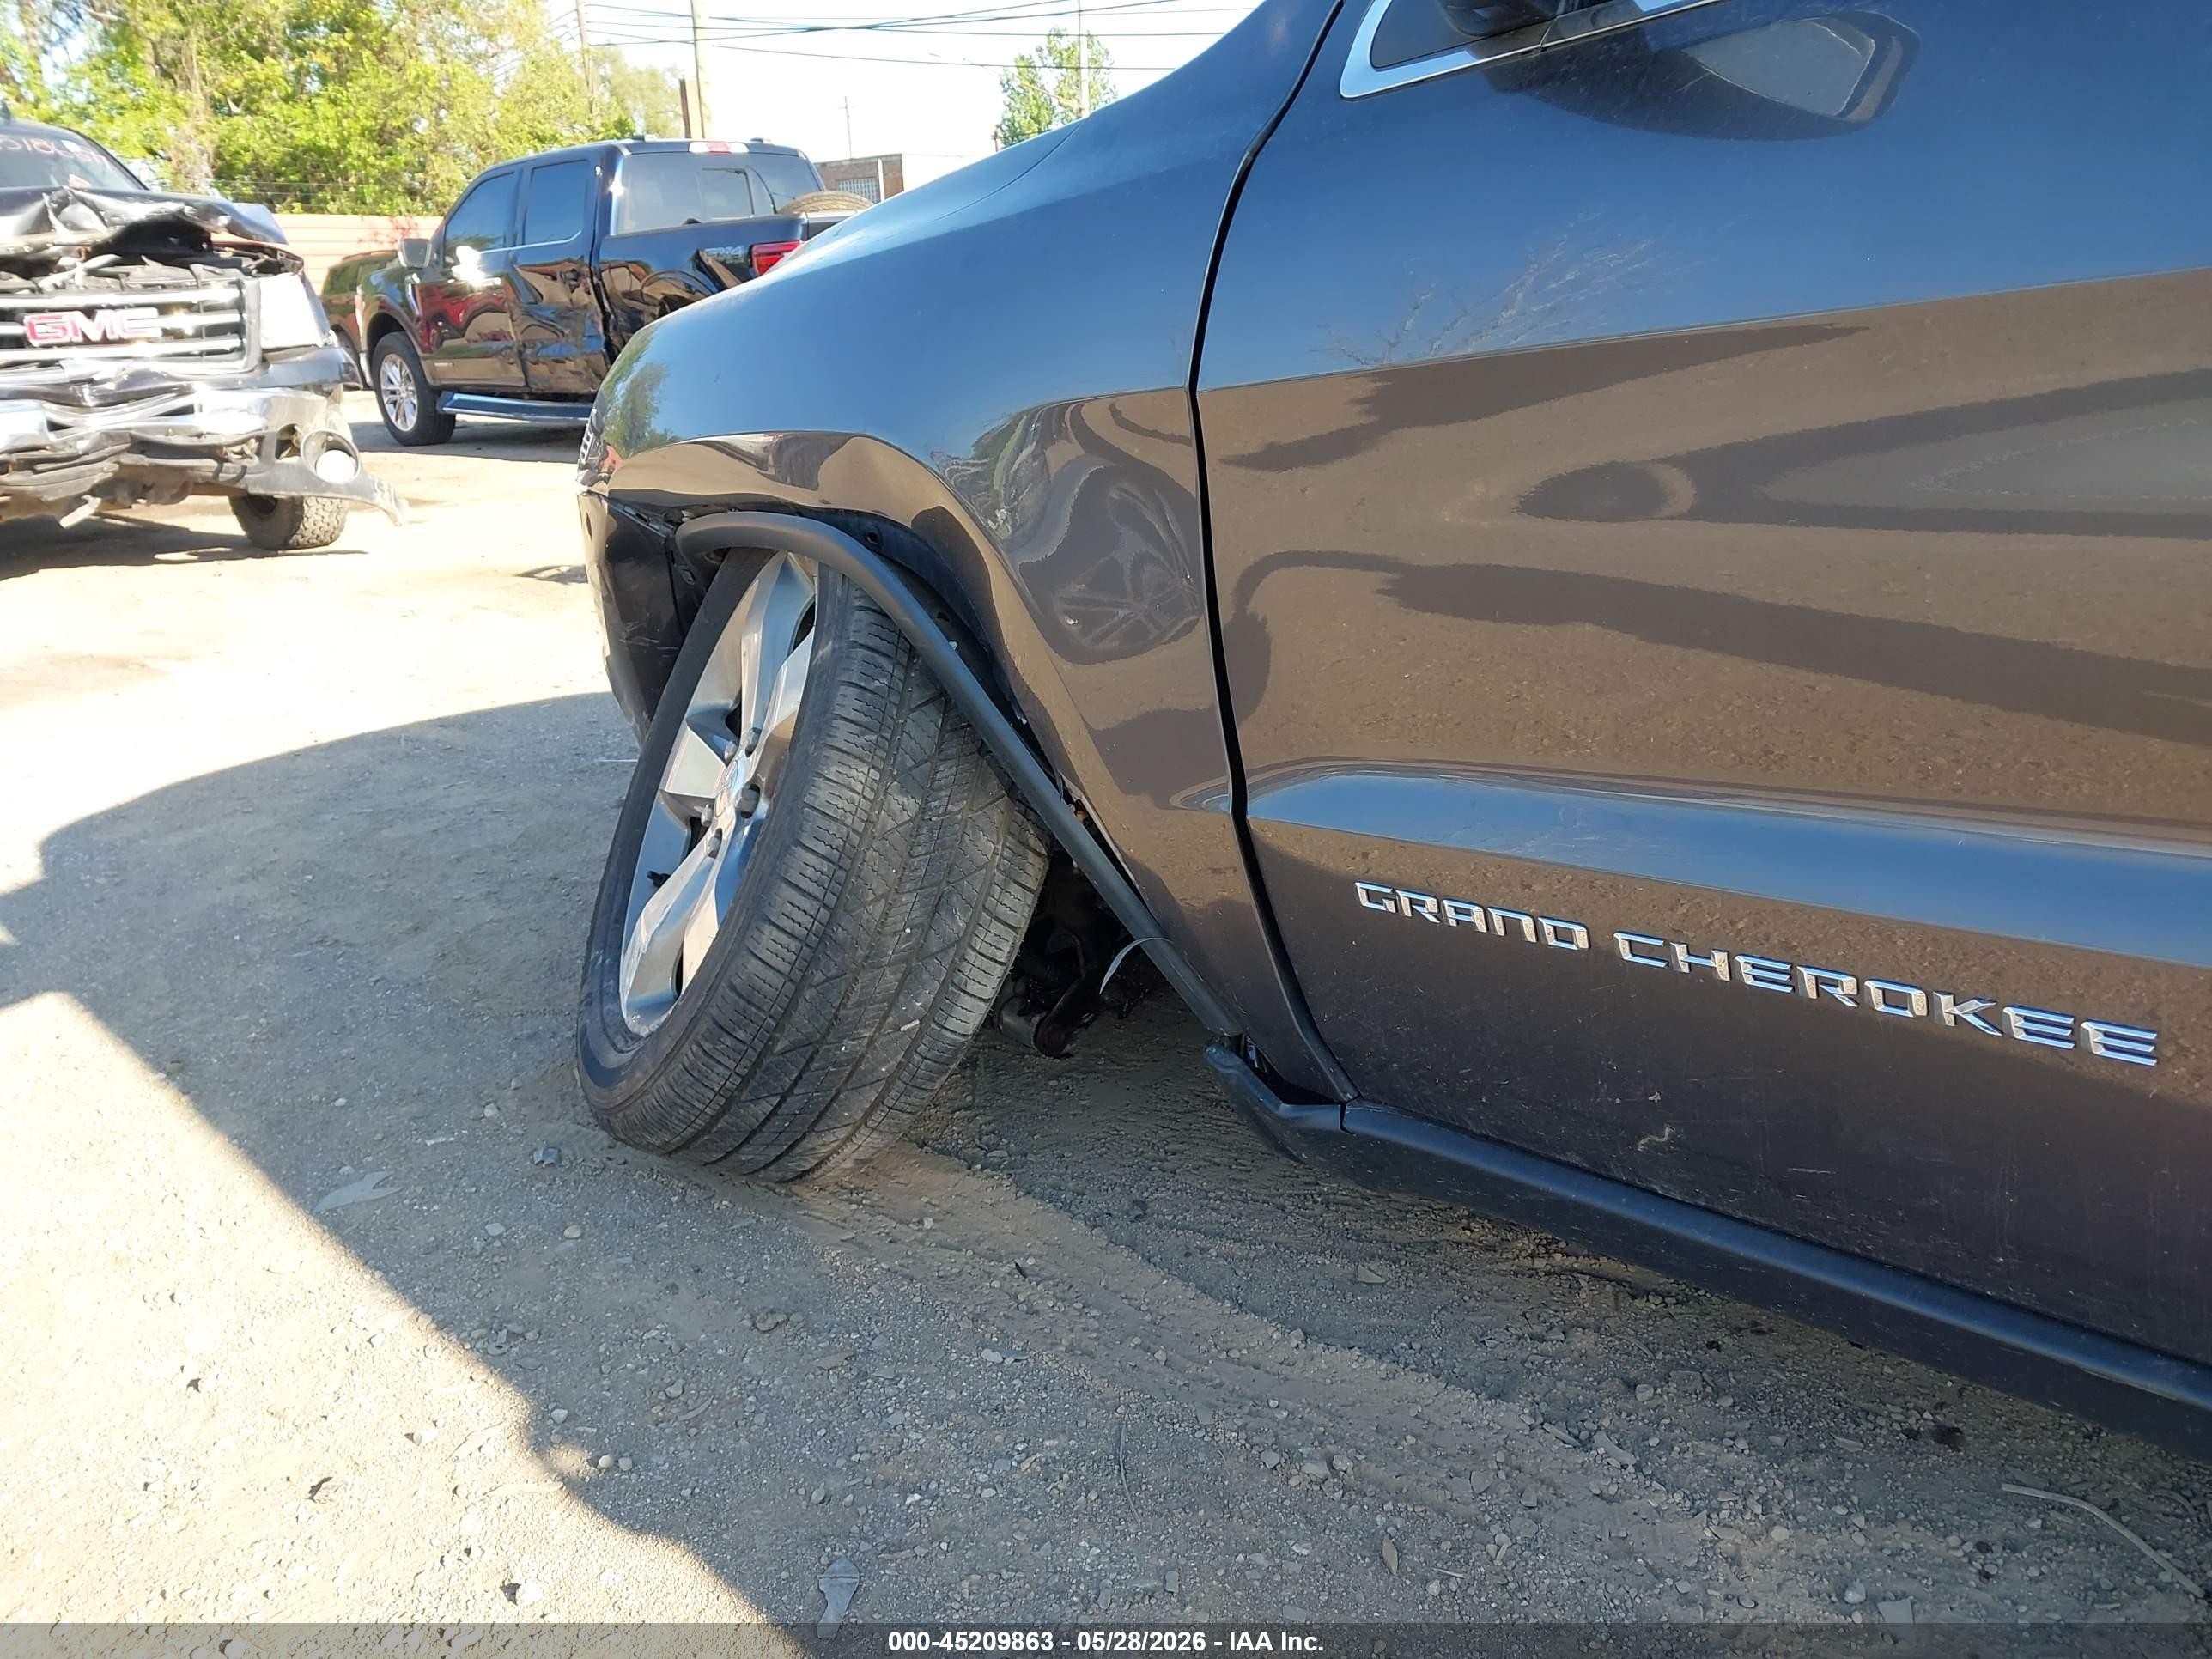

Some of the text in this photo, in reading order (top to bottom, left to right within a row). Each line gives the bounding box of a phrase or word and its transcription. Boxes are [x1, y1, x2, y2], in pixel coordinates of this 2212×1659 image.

[23, 307, 163, 347] GMC
[1354, 881, 2158, 1066] GRAND CHEROKEE
